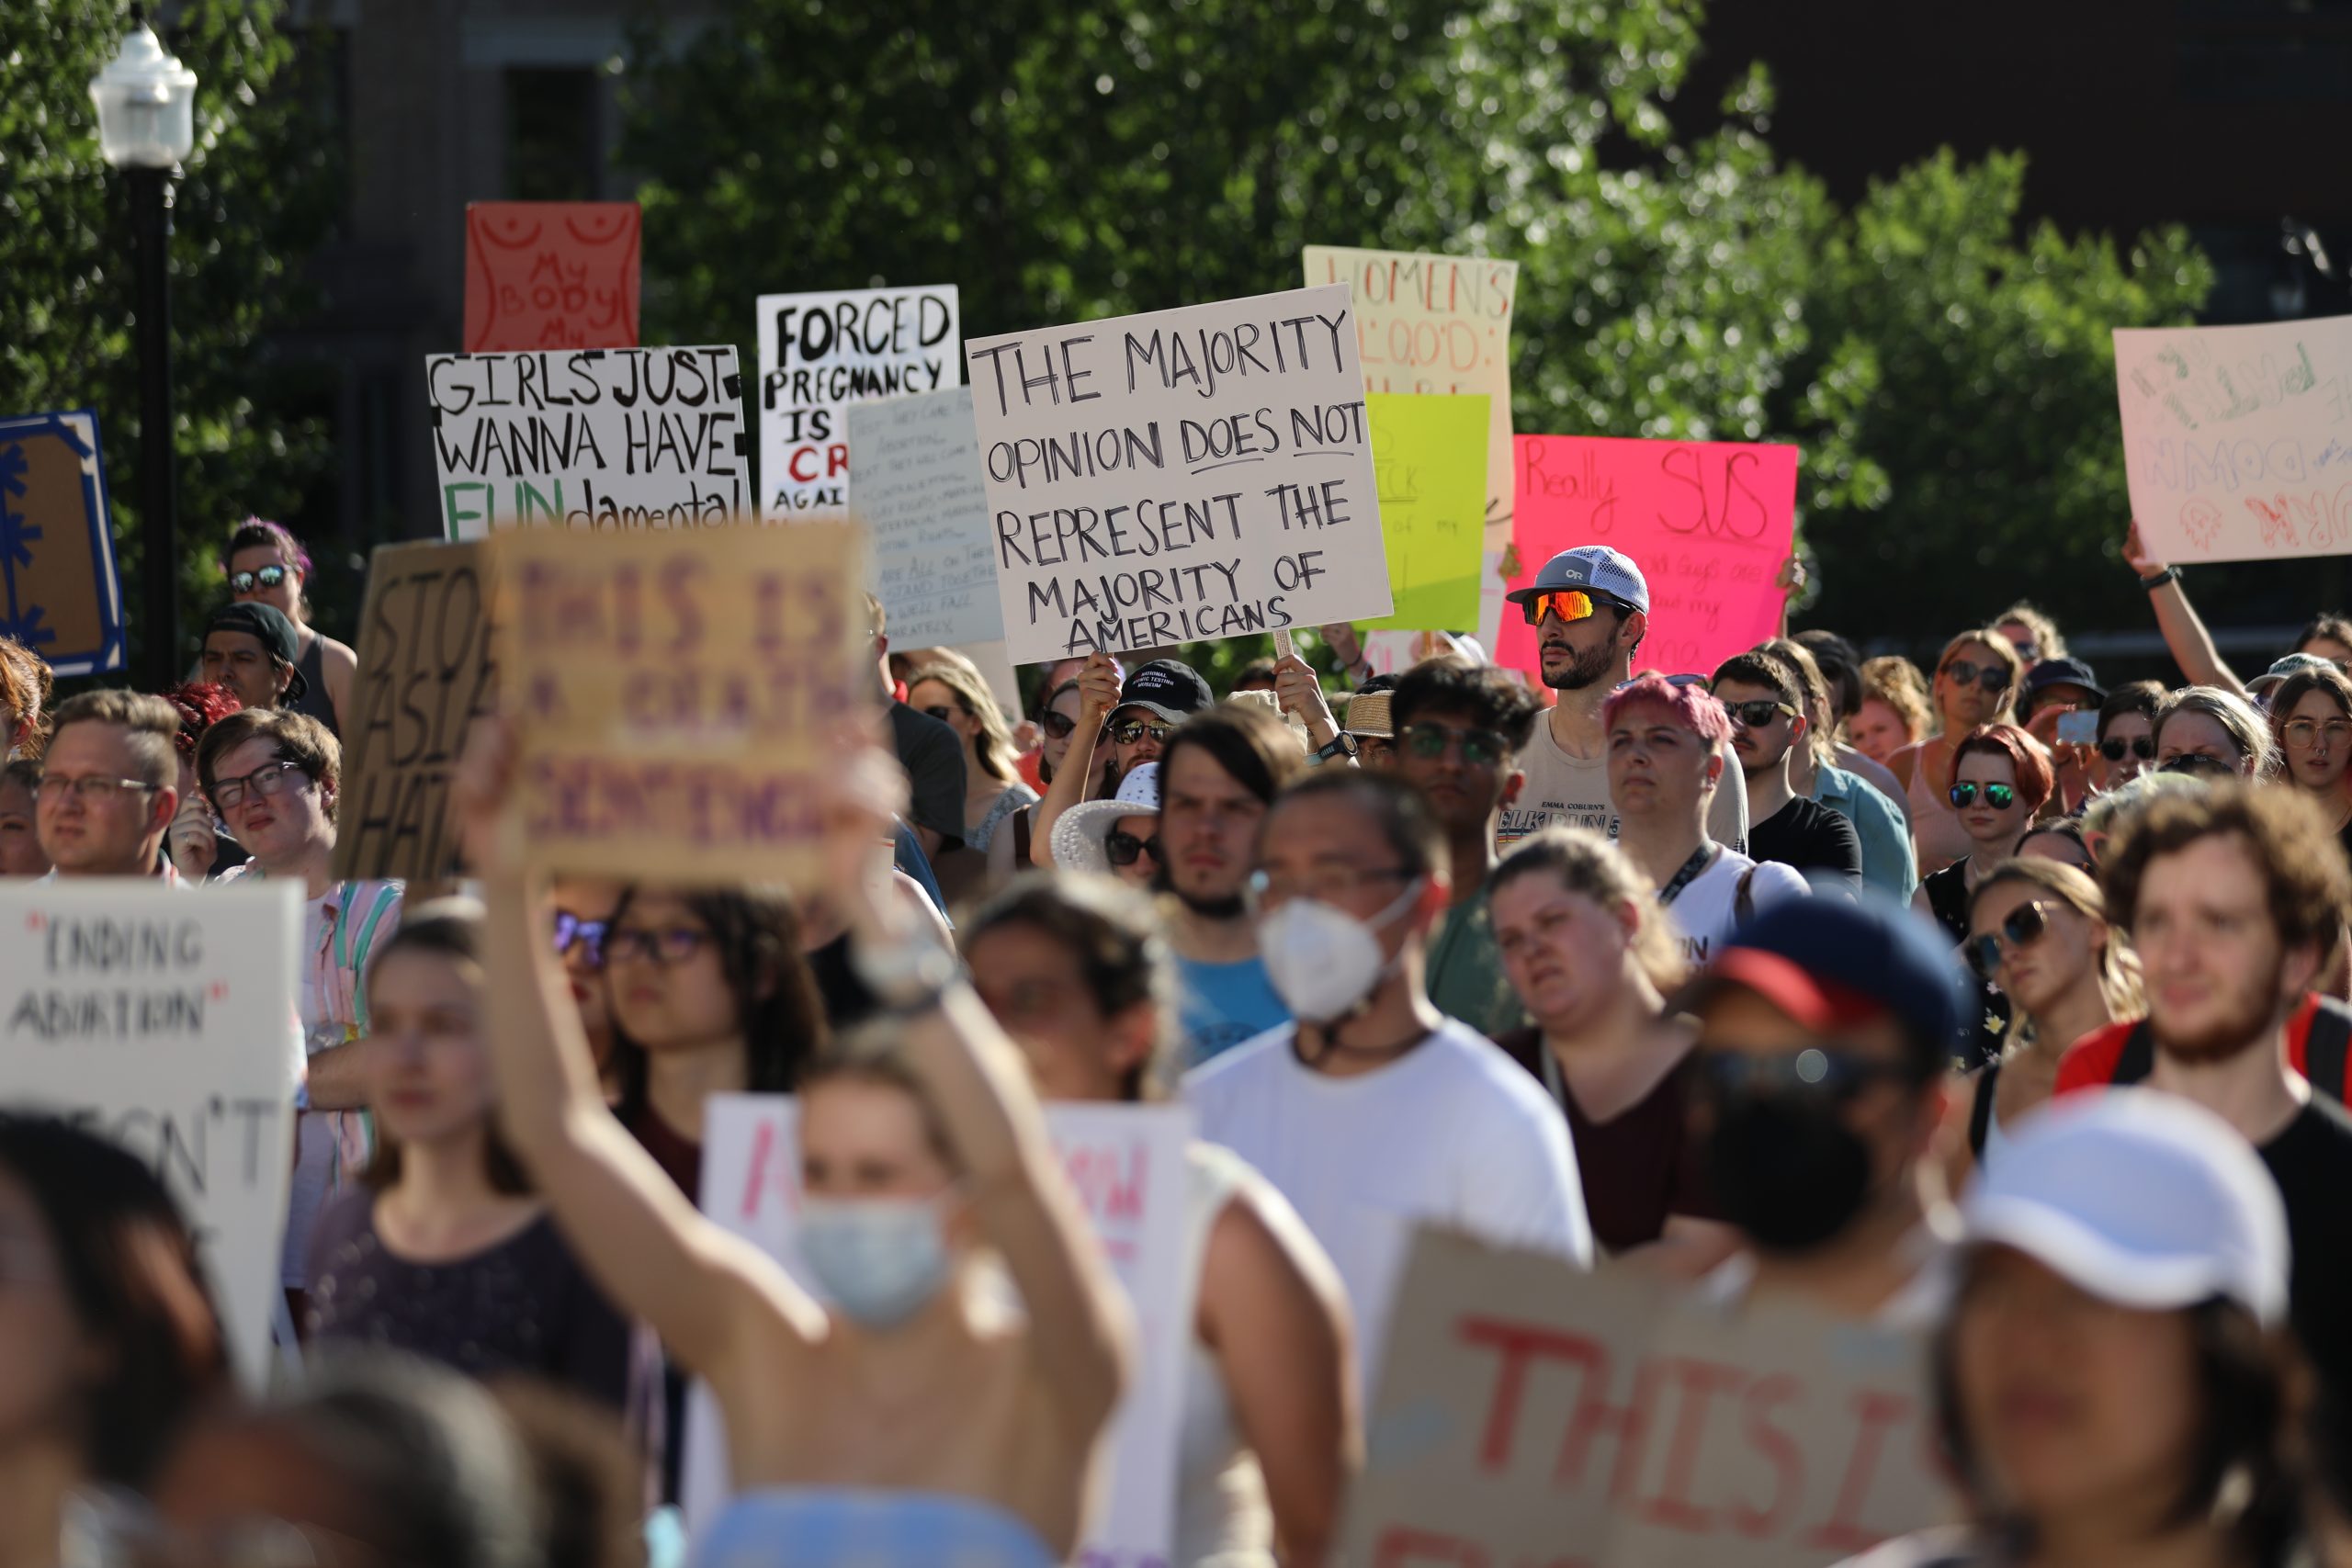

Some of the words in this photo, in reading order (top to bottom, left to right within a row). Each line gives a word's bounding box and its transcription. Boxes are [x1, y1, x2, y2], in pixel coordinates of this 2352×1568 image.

[777, 295, 950, 373] FORCED
[971, 334, 1102, 416] THE
[1125, 310, 1346, 399] MAJORITY
[1358, 316, 1480, 373] LOOD
[429, 353, 601, 415] GIRLS
[613, 349, 731, 407] JUST
[764, 359, 942, 410] PREGNANCY
[436, 412, 606, 478] WANNA
[625, 411, 736, 476] HAVE
[780, 411, 831, 443] IS
[988, 421, 1164, 489] OPINION
[1180, 407, 1280, 464] DOES
[1290, 400, 1365, 448] NOT
[1525, 437, 1620, 536] Really
[1657, 446, 1769, 539] SUS
[997, 491, 1243, 569] REPRESENT
[1264, 479, 1351, 530] THE
[1027, 558, 1241, 626] MAJORITY
[1274, 550, 1326, 592] OF
[1566, 569, 1584, 581] OR
[1062, 595, 1294, 656] AMERICANS
[346, 770, 475, 879] HAT
[1498, 809, 1545, 830] ELK
[1542, 801, 1565, 809] EMMA
[1454, 1312, 1810, 1540] THIS
